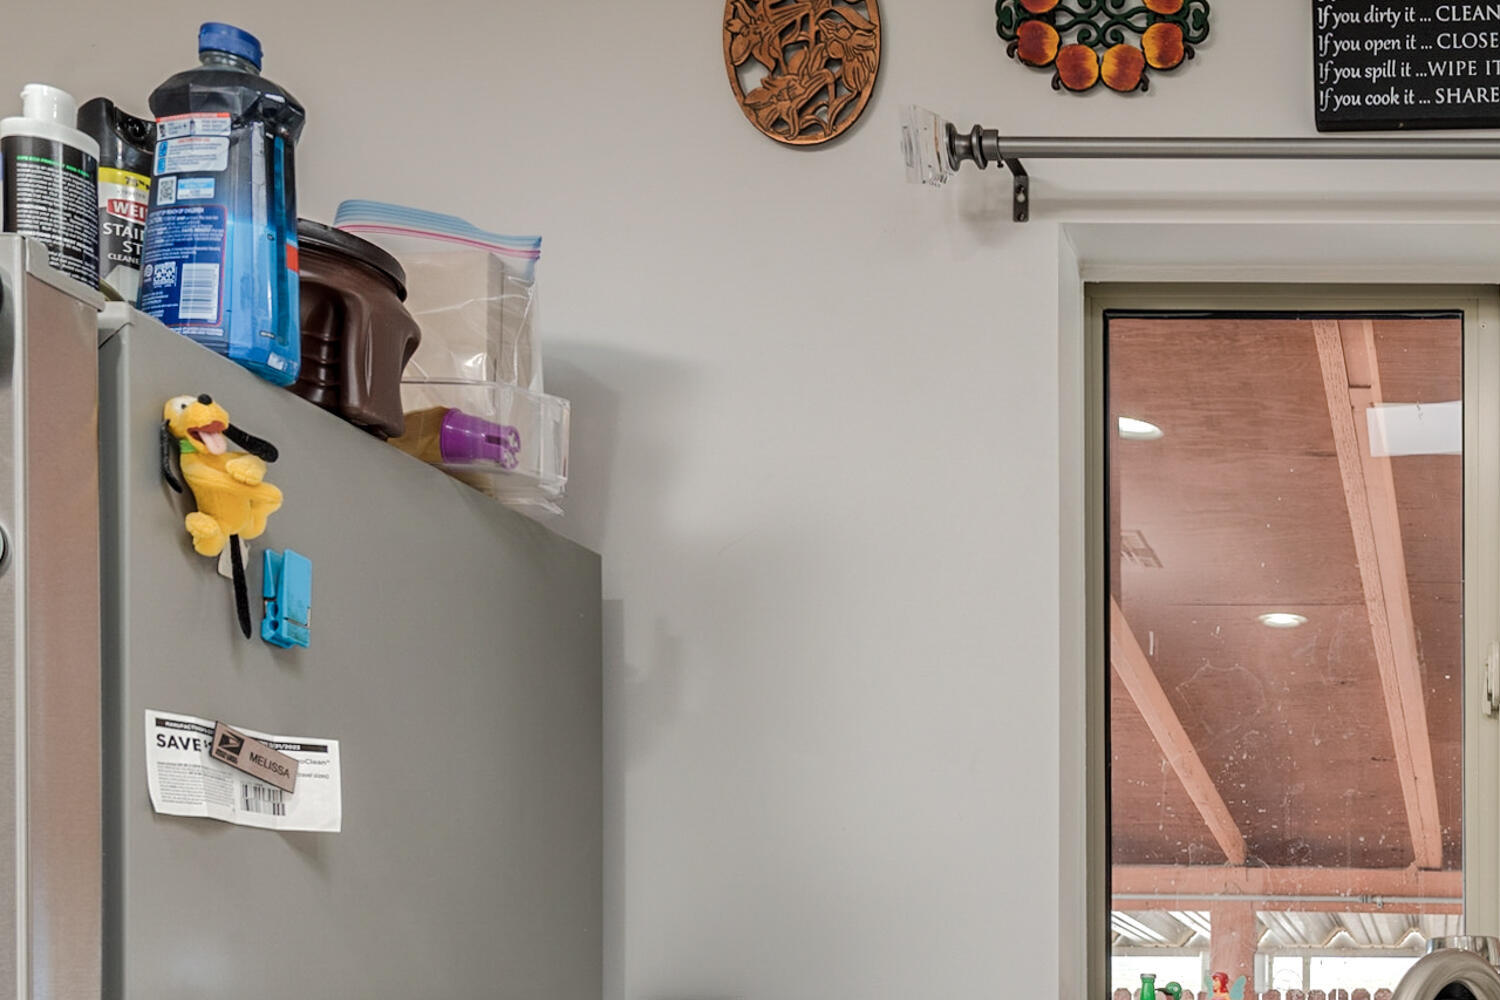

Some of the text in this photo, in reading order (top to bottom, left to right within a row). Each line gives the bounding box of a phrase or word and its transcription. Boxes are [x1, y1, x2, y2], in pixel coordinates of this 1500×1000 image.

[1318, 5, 1333, 29] If
[1332, 12, 1361, 29] you
[1364, 4, 1401, 28] dirty
[1405, 6, 1416, 22] it
[1318, 32, 1334, 57] If
[1332, 39, 1361, 57] you
[1364, 38, 1402, 56] open
[1406, 34, 1417, 50] it
[1436, 31, 1500, 49] CLOSE
[1319, 60, 1334, 84] If
[1333, 67, 1362, 84] you
[1364, 59, 1397, 84] spill
[1400, 61, 1412, 77] it
[1319, 87, 1334, 112] If
[1333, 94, 1362, 112] you
[1364, 85, 1400, 106] cook
[1403, 88, 1416, 105] it
[1434, 86, 1500, 104] SHARE
[112, 200, 145, 219] WEI
[156, 733, 202, 752] SAVE
[248, 751, 291, 779] MELISSA
